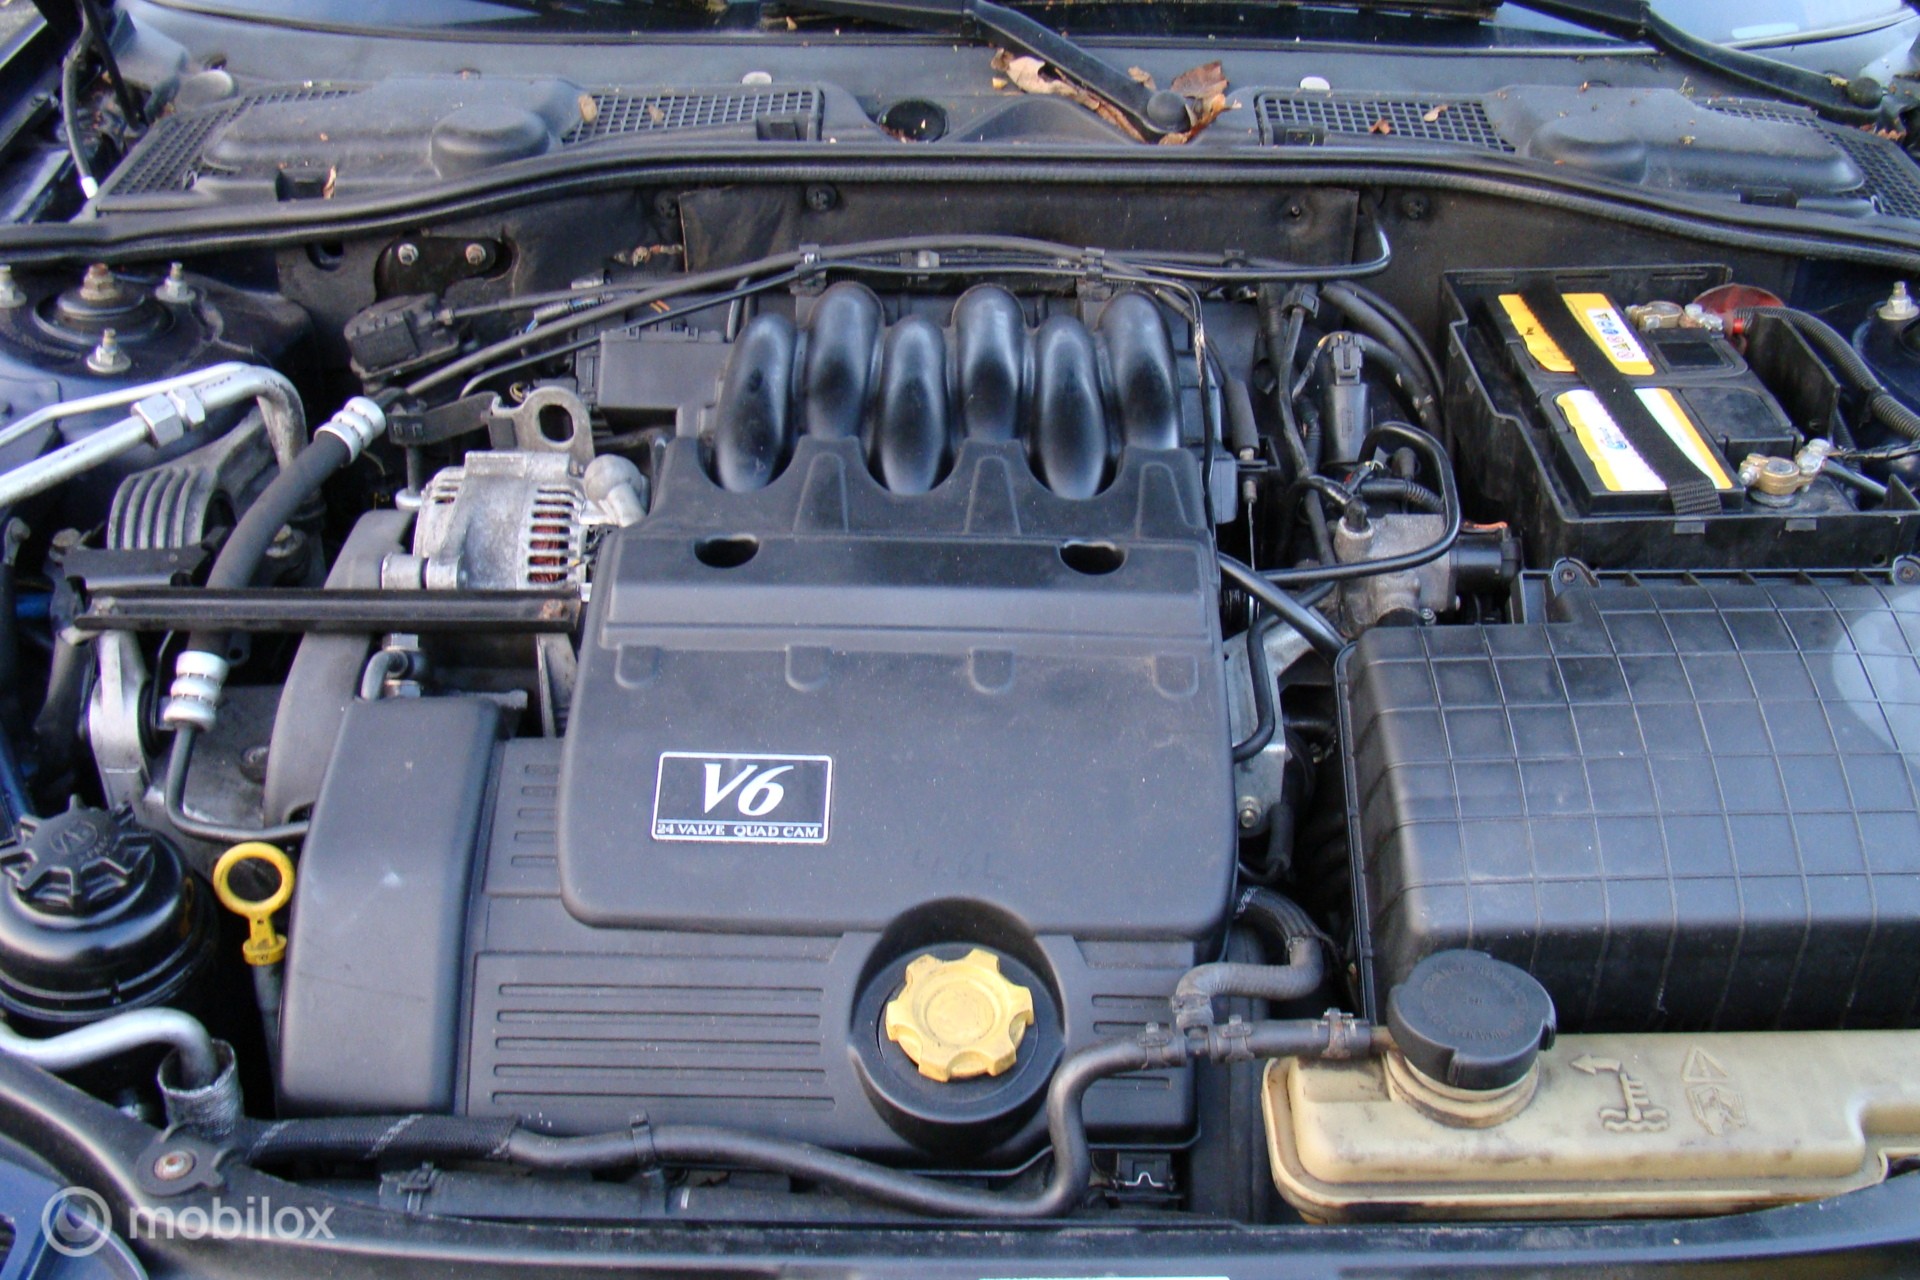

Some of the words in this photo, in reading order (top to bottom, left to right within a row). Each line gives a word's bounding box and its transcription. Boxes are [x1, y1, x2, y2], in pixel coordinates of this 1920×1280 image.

[704, 762, 794, 817] V6
[657, 823, 674, 834] 24
[678, 824, 725, 836] VALVE
[733, 825, 780, 838] QUAD
[783, 826, 819, 838] CAM
